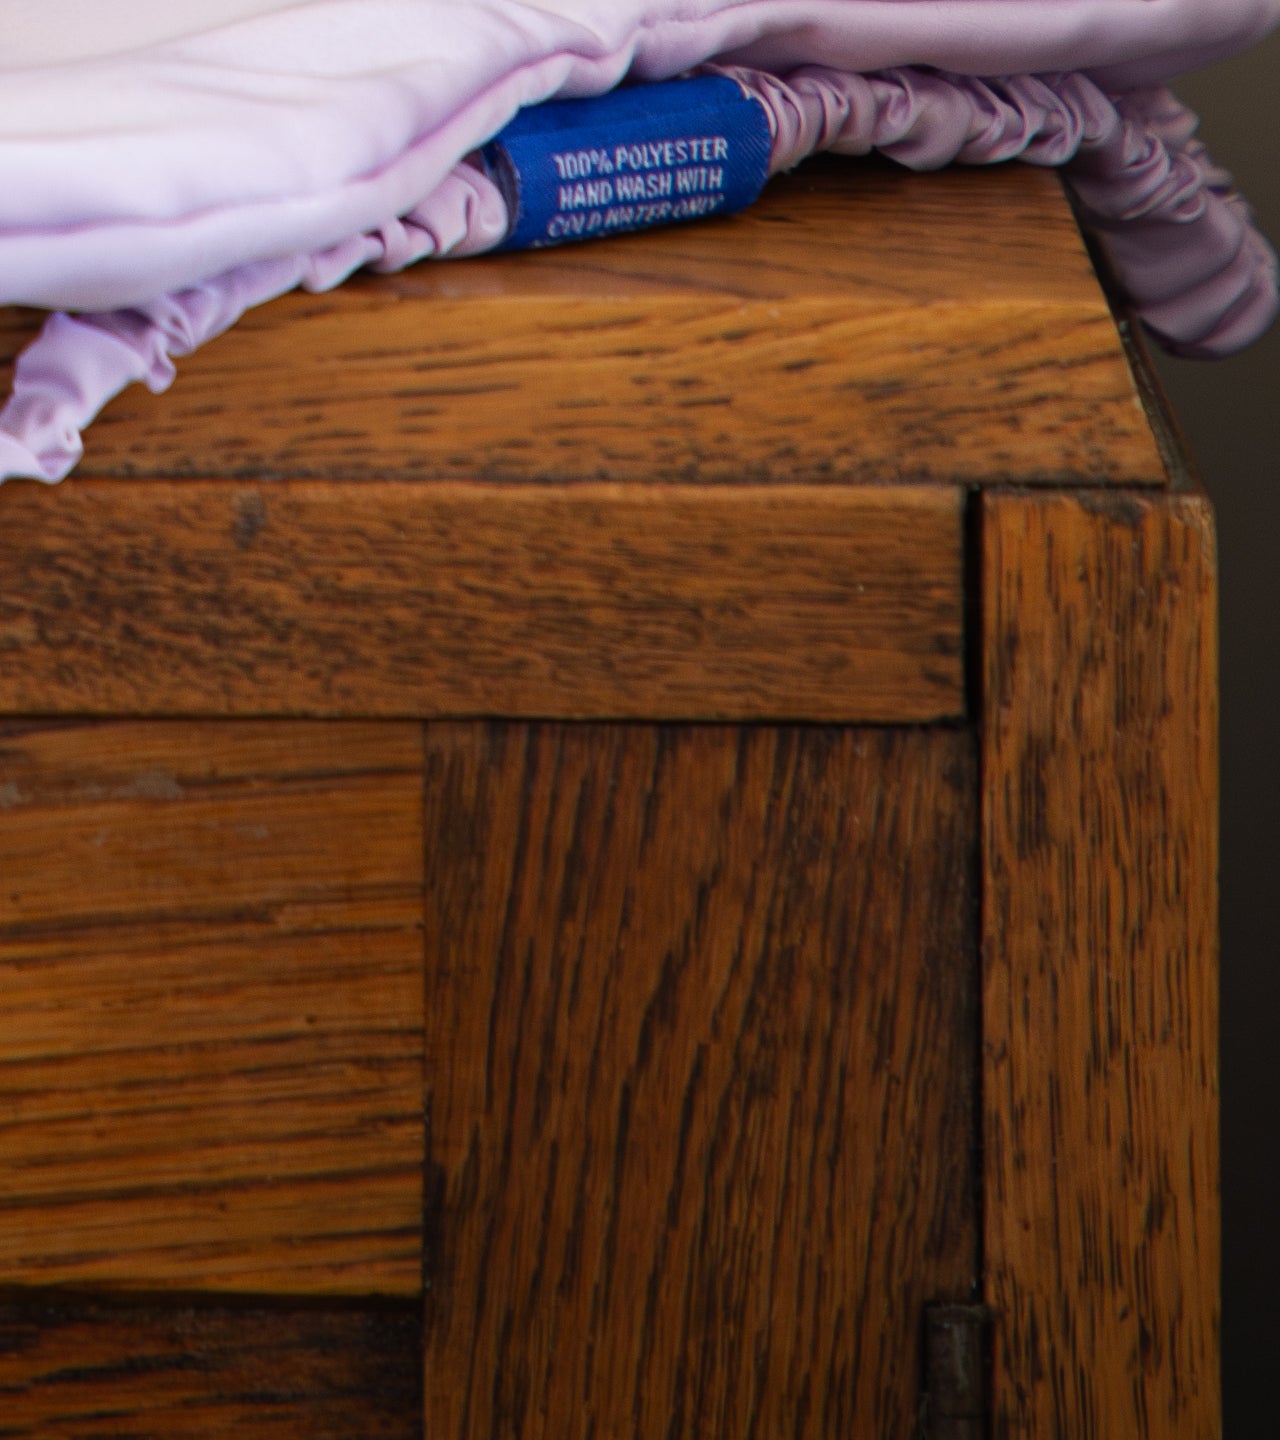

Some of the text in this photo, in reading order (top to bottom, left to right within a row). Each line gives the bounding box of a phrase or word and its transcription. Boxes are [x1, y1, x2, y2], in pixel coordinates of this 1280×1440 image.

[553, 136, 729, 180] 100% POLYESTER
[559, 165, 725, 212] HAND WASH WITH
